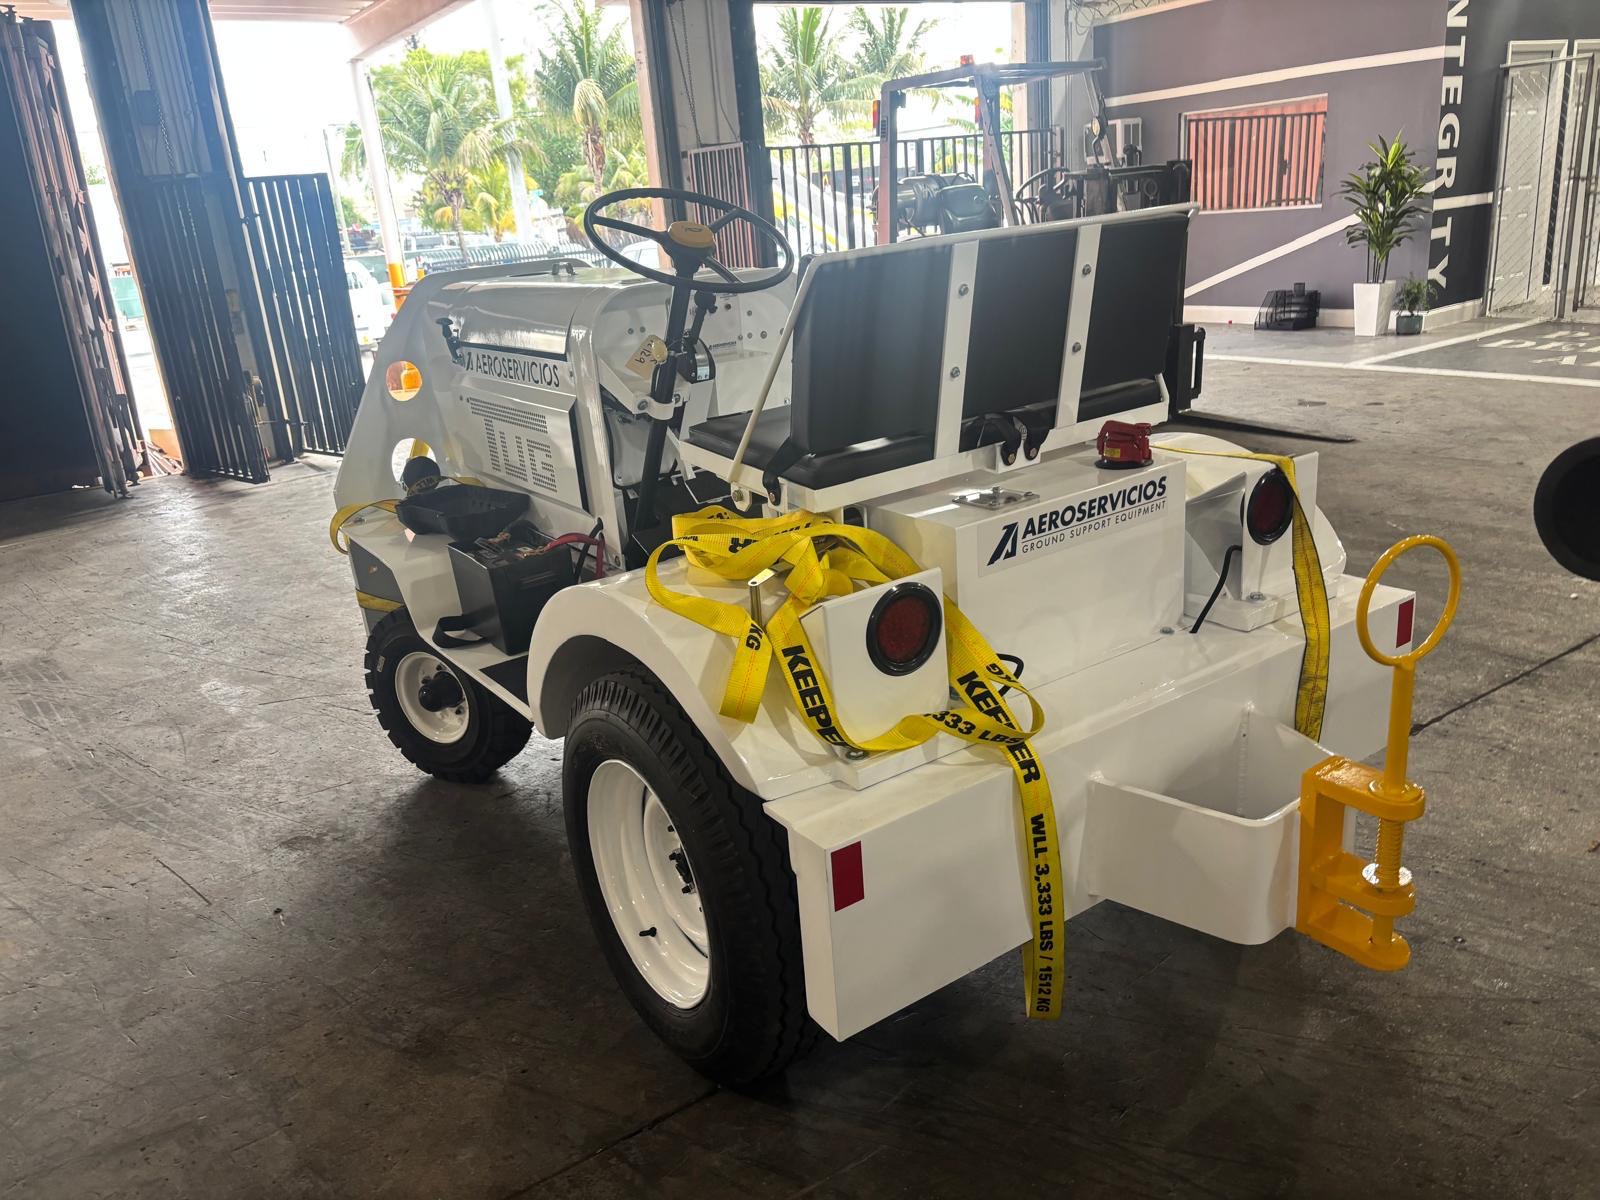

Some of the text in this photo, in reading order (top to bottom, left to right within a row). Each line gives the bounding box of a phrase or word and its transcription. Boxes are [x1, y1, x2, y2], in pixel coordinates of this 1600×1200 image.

[476, 353, 560, 388] AEROSERVICIOS
[1021, 475, 1168, 540] AEROSERVICIOS
[1021, 500, 1167, 554] GROUND SUPPORT EQUIPMENT
[745, 623, 763, 651] KG
[1030, 813, 1048, 858] WLL
[1034, 863, 1053, 917] 3,333
[1038, 920, 1054, 953] LBS
[1037, 965, 1053, 994] 1512
[1036, 996, 1053, 1013] KG
